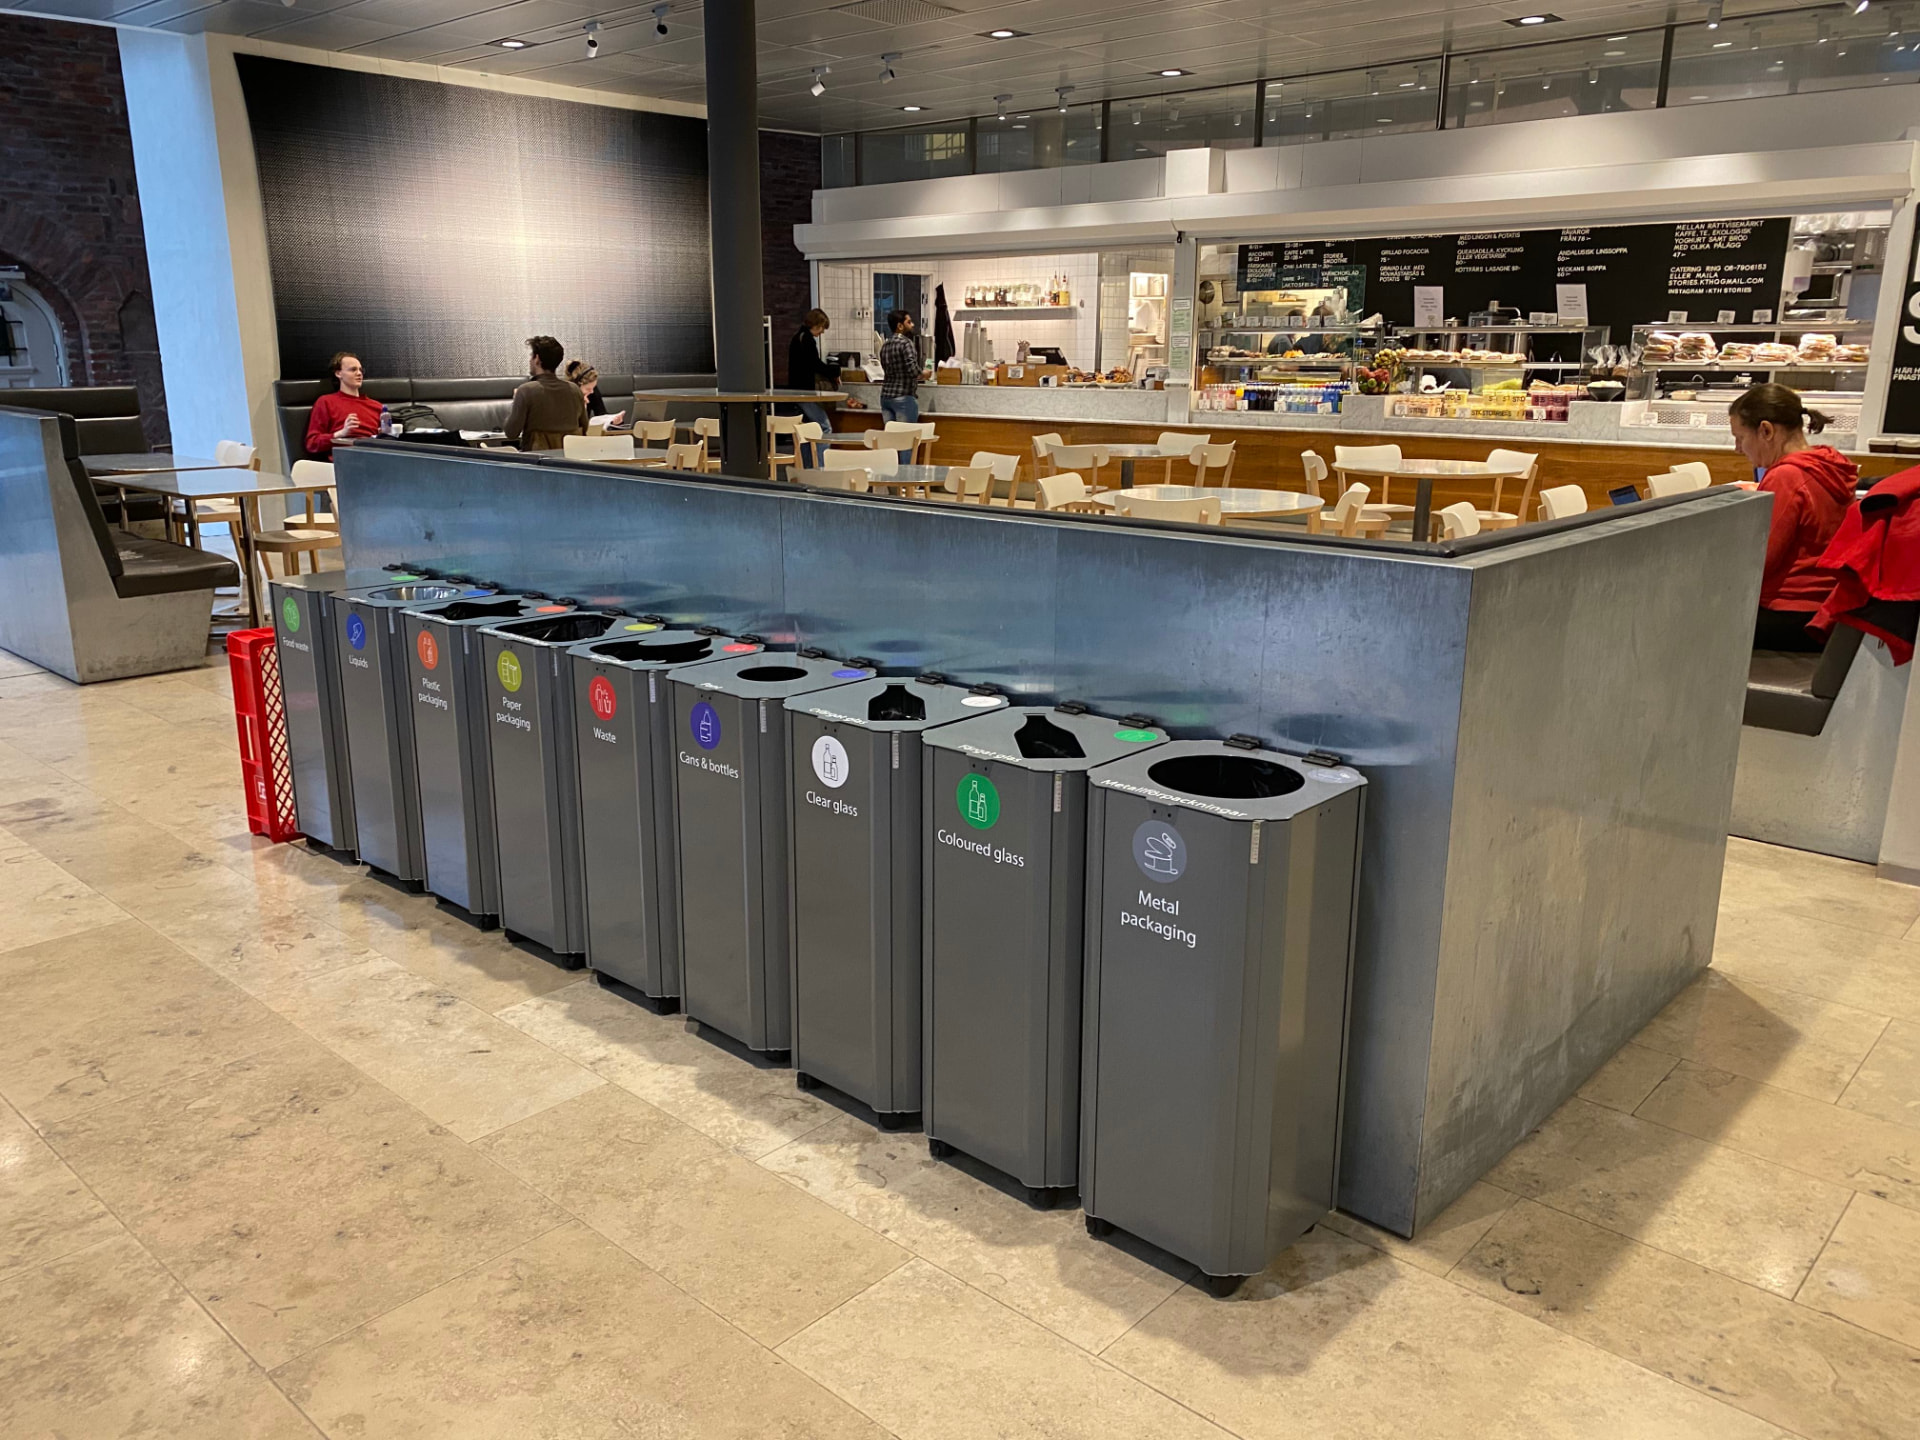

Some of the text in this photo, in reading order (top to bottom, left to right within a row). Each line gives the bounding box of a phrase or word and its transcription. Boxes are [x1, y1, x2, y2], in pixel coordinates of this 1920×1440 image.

[1676, 223, 1705, 231] MELLAN
[1674, 236, 1706, 244] YOGHURT
[348, 654, 369, 669] Liquids
[422, 677, 441, 692] Plastic
[418, 692, 448, 711] packaging
[502, 696, 522, 711] Paper
[495, 712, 531, 732] packaging
[593, 727, 617, 744] Waste
[679, 751, 739, 779] Cans & bottles
[806, 790, 858, 818] Clear glass
[1100, 779, 1248, 818] Metallförpackningar
[937, 829, 1025, 868] Coloured glass
[1137, 890, 1179, 917] Metal
[1120, 910, 1197, 949] packaging
